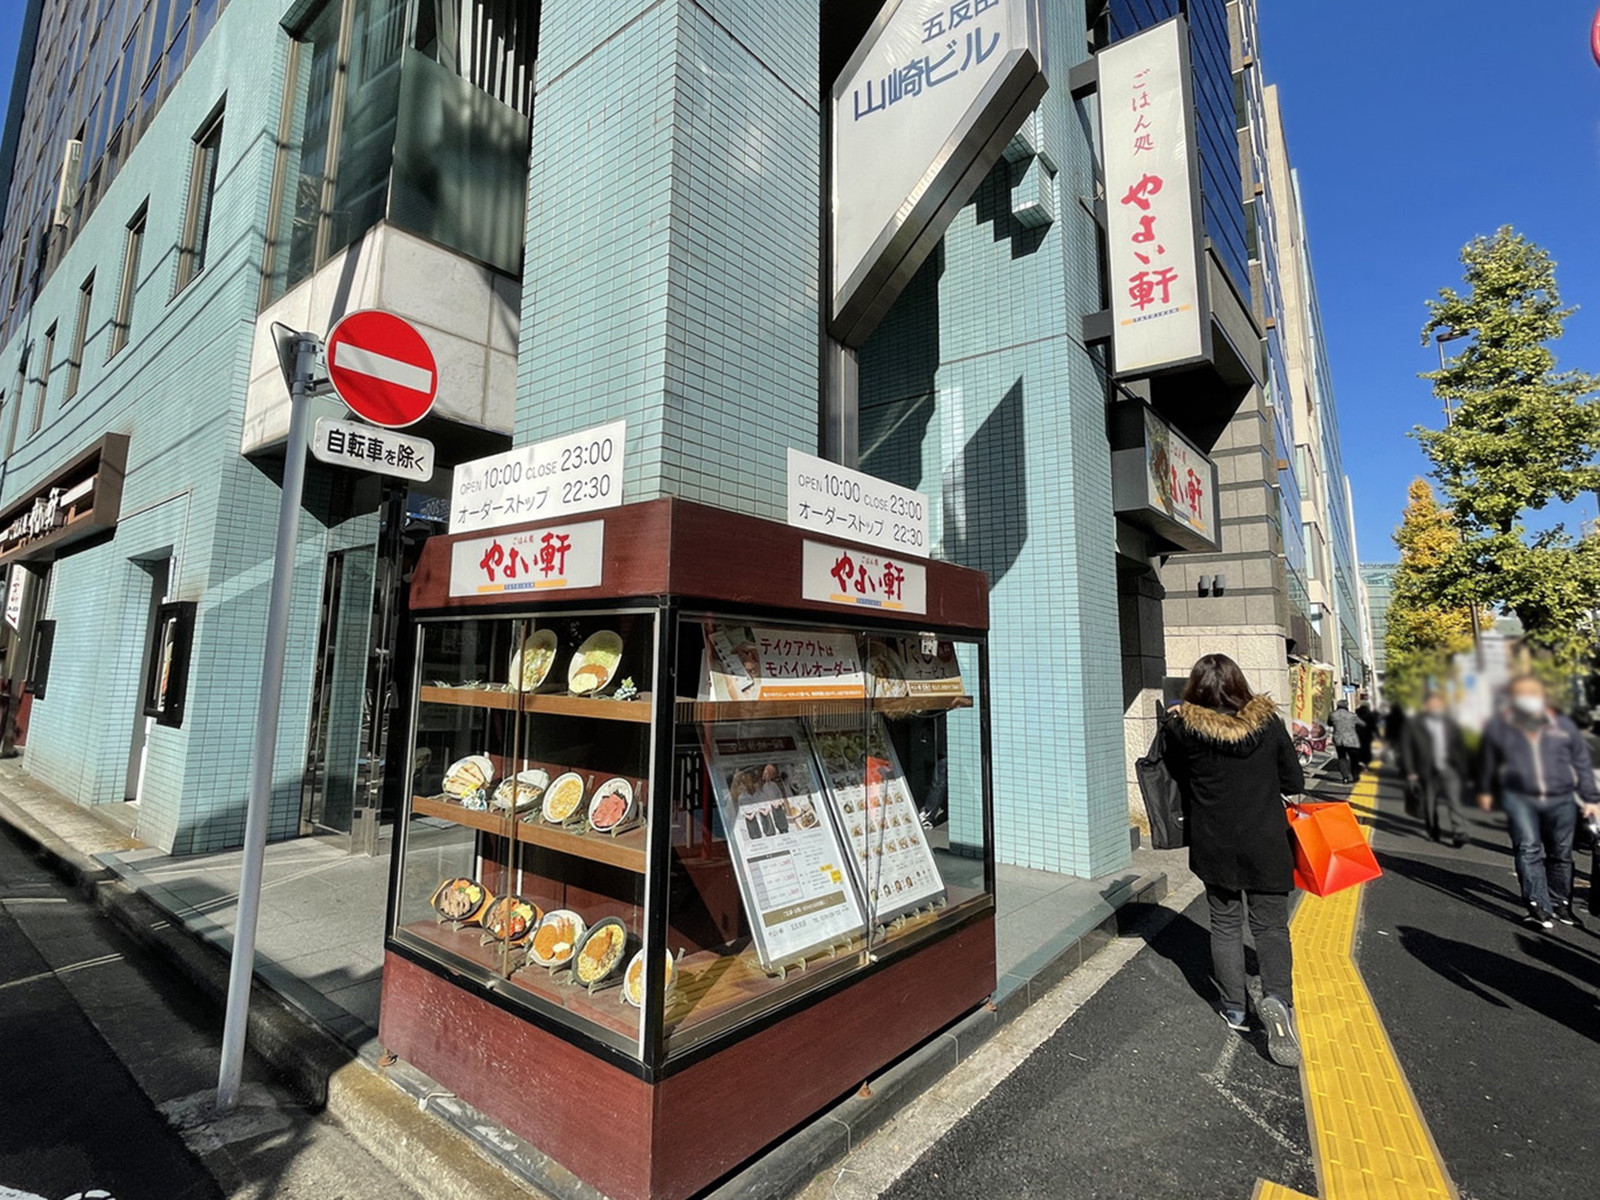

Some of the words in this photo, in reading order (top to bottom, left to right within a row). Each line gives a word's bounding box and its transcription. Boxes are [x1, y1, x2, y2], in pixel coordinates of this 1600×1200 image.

[853, 27, 1000, 121] 山崎ビル
[1132, 68, 1154, 157] ごはん処
[1120, 173, 1179, 311] やよい軒
[326, 428, 425, 472] 自転車を除く
[460, 481, 482, 495] OPEN
[484, 461, 522, 491] 10:00
[525, 461, 558, 480] CLOSE
[561, 438, 613, 472] 23:00
[457, 487, 550, 524] オーダーストップ
[562, 474, 611, 504] 22:30
[798, 474, 823, 492] OPEN
[824, 474, 861, 503] 10:00
[863, 494, 889, 512] CLOSE
[890, 494, 923, 521] 23:00
[799, 501, 885, 537] オーダーストップ
[893, 523, 923, 547] 22:30
[480, 532, 572, 582] やよい軒
[831, 551, 905, 600] やよい軒
[760, 638, 834, 657] テイクアウトは
